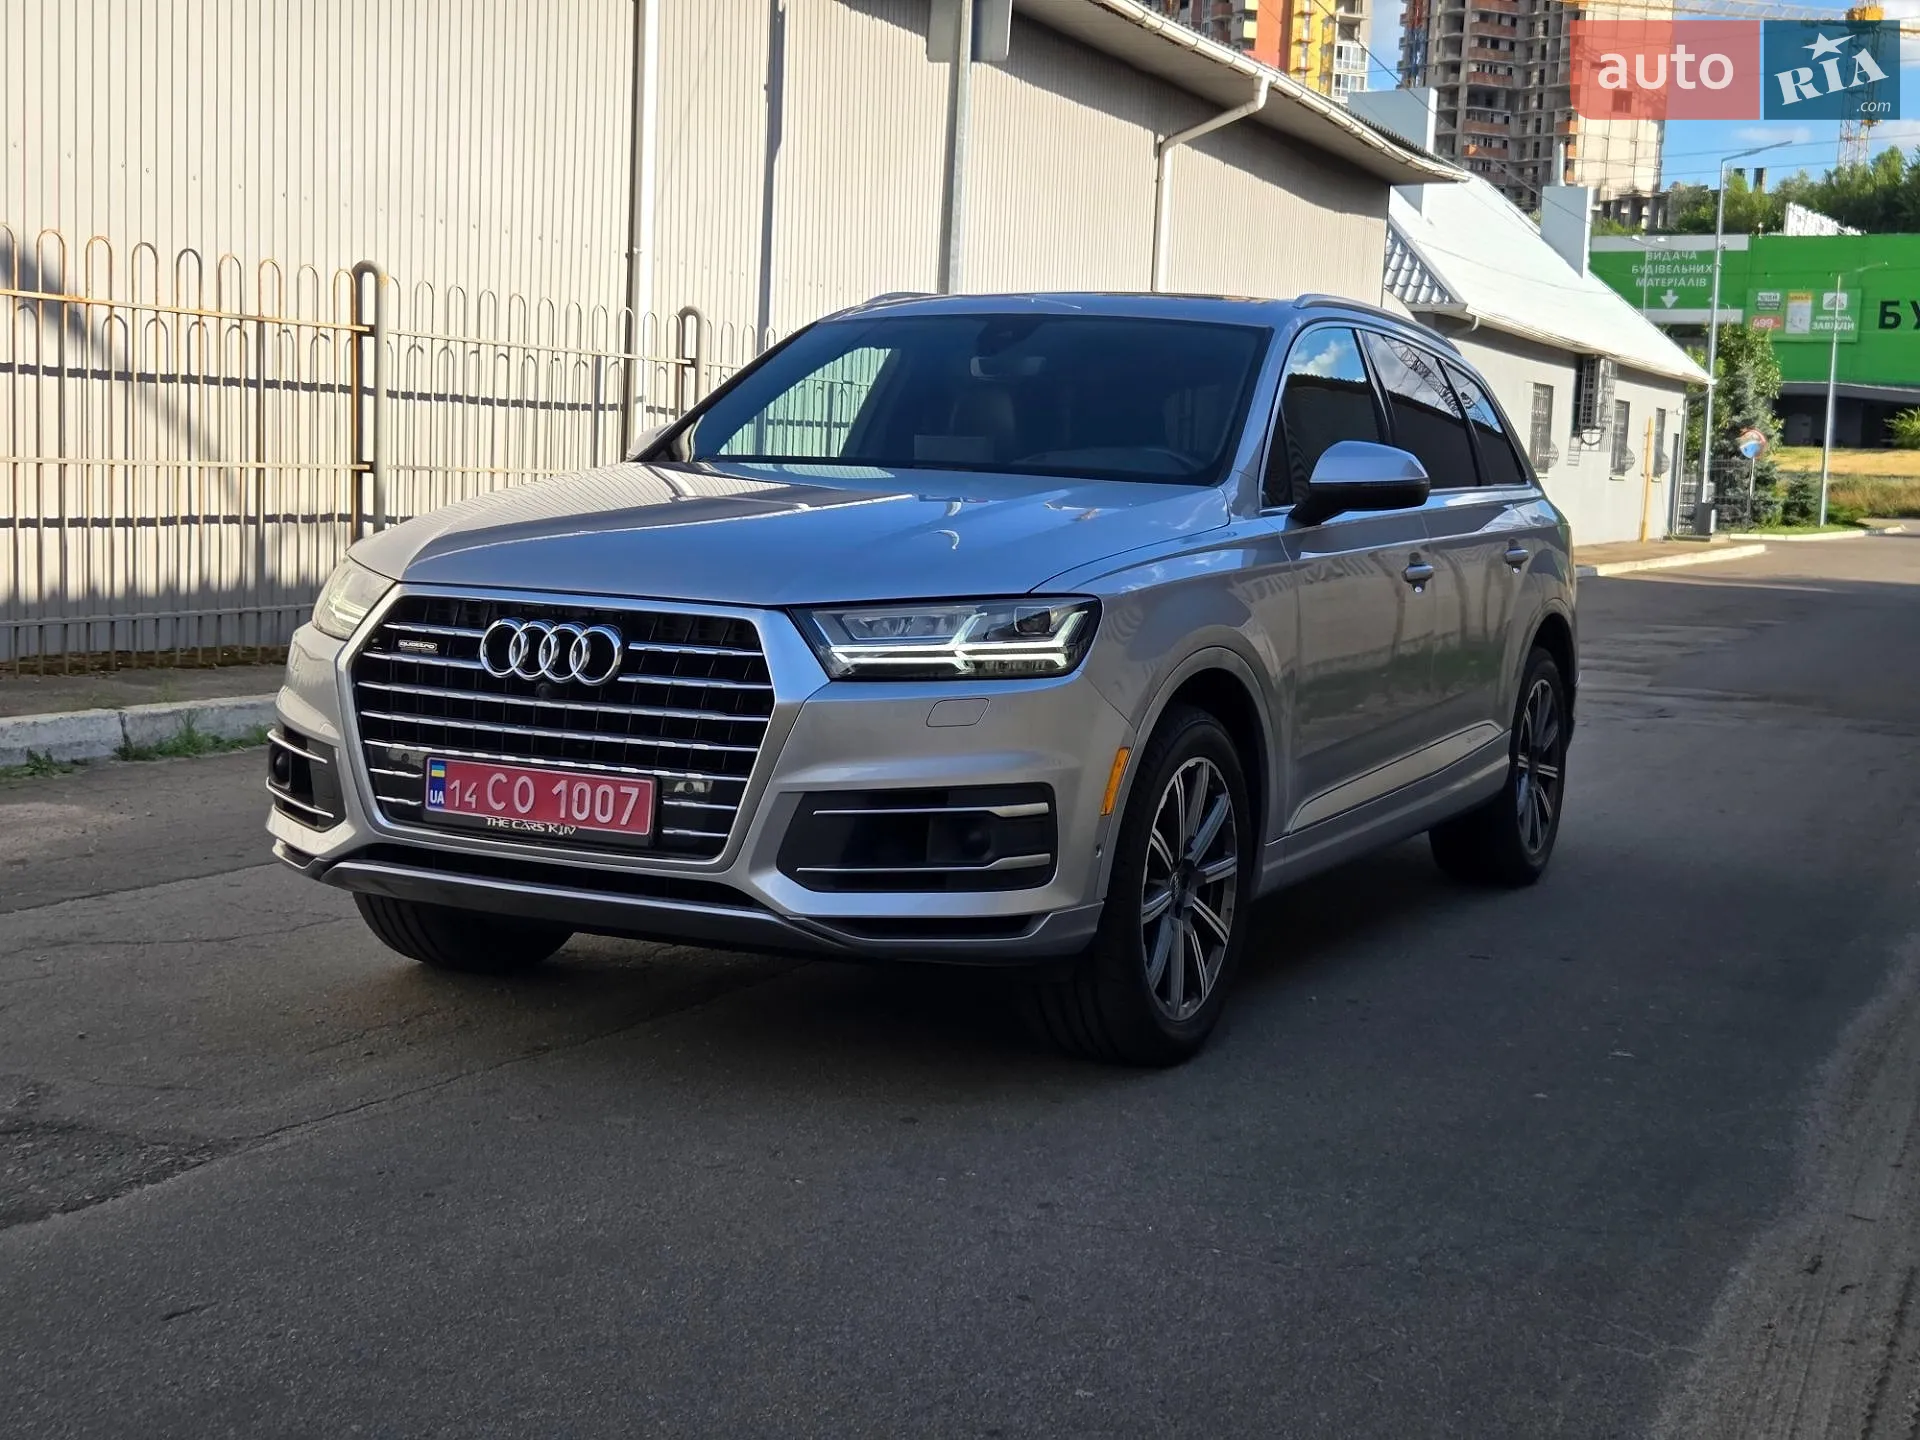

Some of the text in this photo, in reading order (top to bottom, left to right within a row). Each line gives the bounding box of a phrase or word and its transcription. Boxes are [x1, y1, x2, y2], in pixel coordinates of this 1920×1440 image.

[1646, 250, 1697, 262] ВИДАЧА
[1631, 264, 1713, 275] БУДІВЕЛЬНИХ
[1635, 277, 1707, 288] МАТЕРІАЛІВ
[429, 790, 445, 804] UA
[449, 772, 640, 825] 14 CO 1007
[486, 817, 510, 828] THE
[512, 820, 545, 832] CARS
